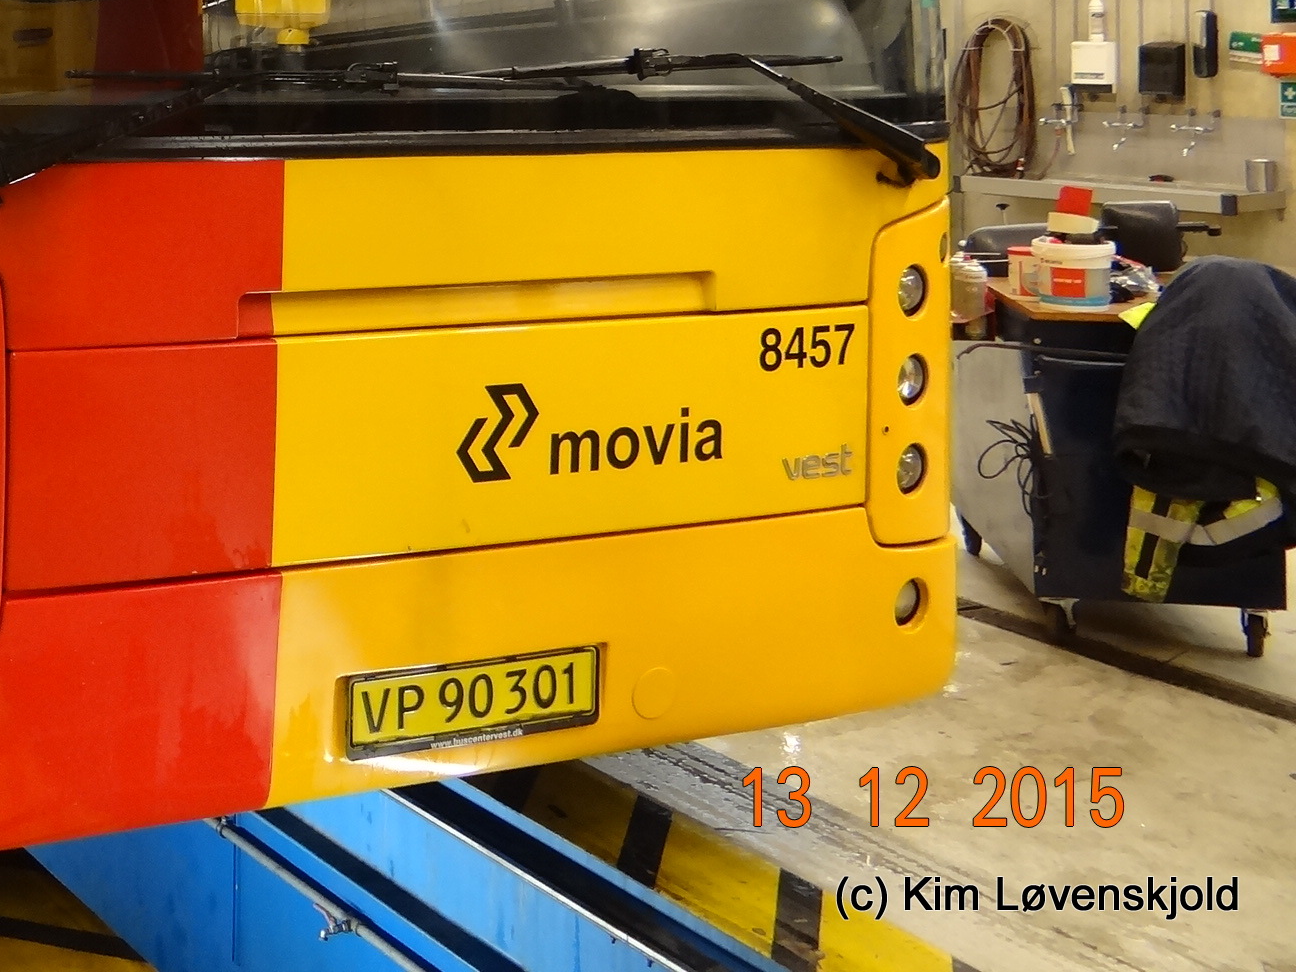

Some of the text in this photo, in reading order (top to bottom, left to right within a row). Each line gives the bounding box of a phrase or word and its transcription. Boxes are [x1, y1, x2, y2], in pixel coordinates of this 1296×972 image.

[759, 323, 855, 372] 8457
[549, 406, 724, 475] movia
[781, 442, 854, 481] vest
[361, 662, 575, 734] VP 90 301
[429, 726, 524, 750] www.buscentervest.dk
